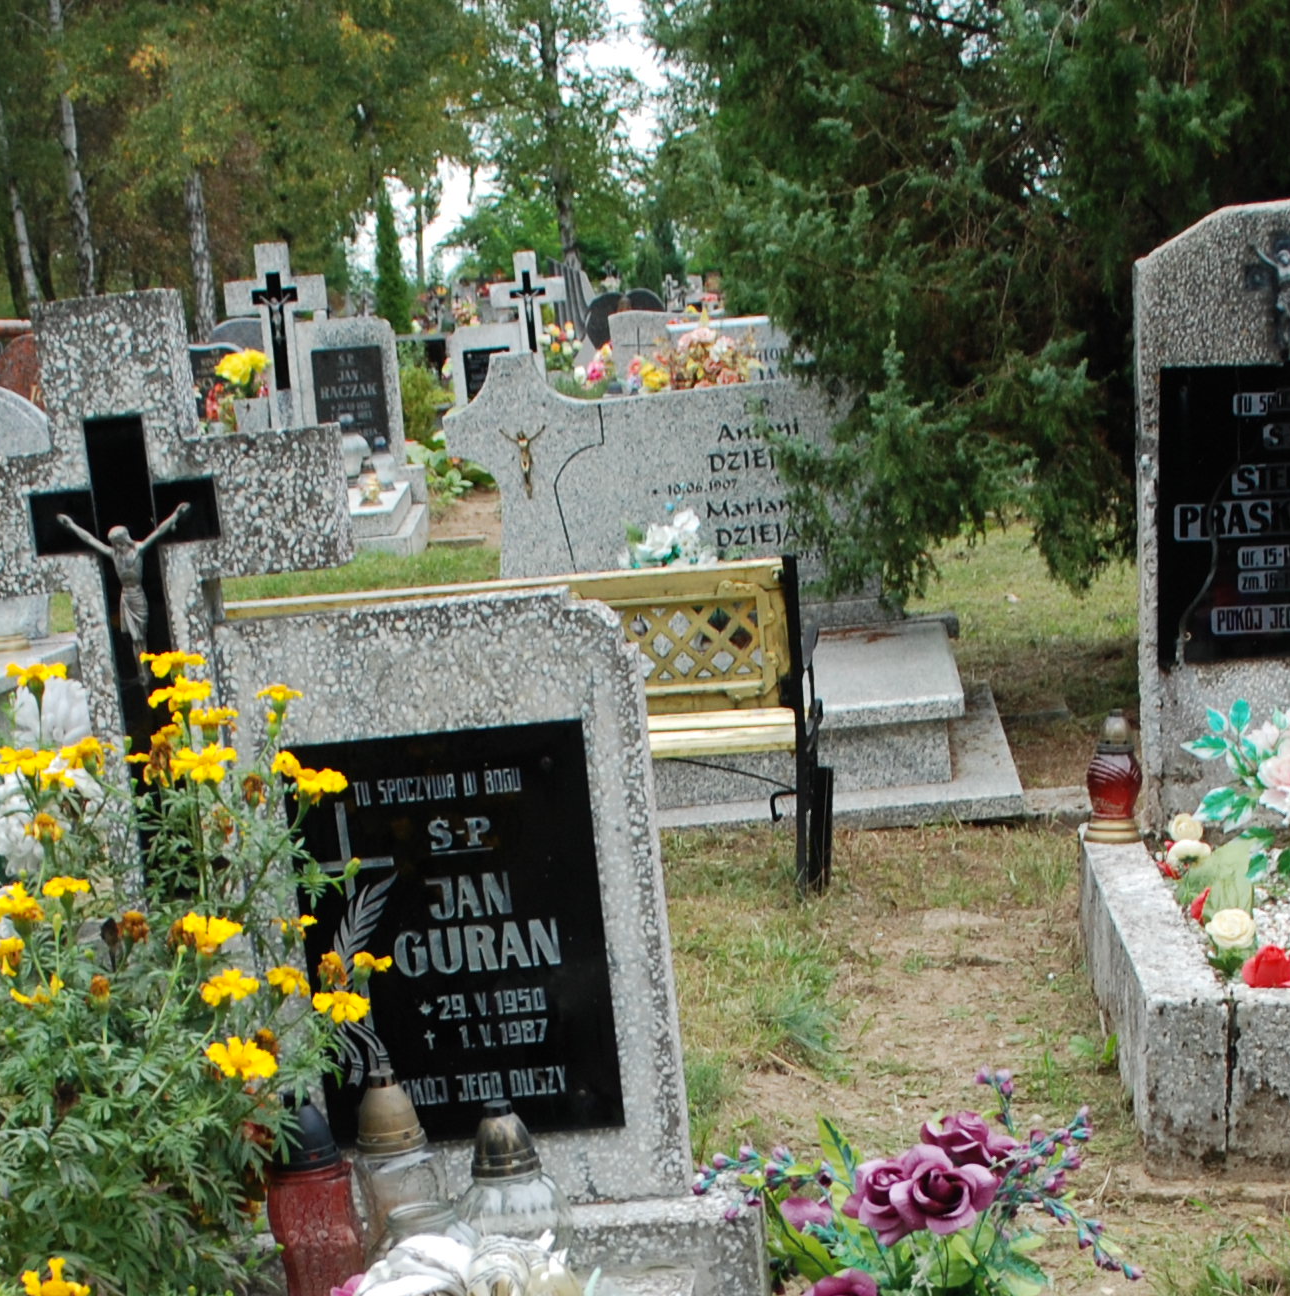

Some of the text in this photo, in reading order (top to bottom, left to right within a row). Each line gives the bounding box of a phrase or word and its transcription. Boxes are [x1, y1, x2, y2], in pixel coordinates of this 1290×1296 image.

[1216, 606, 1263, 632] POKÓJ
[352, 767, 523, 807] TU SPOCZYWA W BOGU
[424, 871, 513, 921] JAN
[393, 917, 562, 978] GURAN
[401, 1064, 567, 1106] OKÓJ JEGO DUSZY
